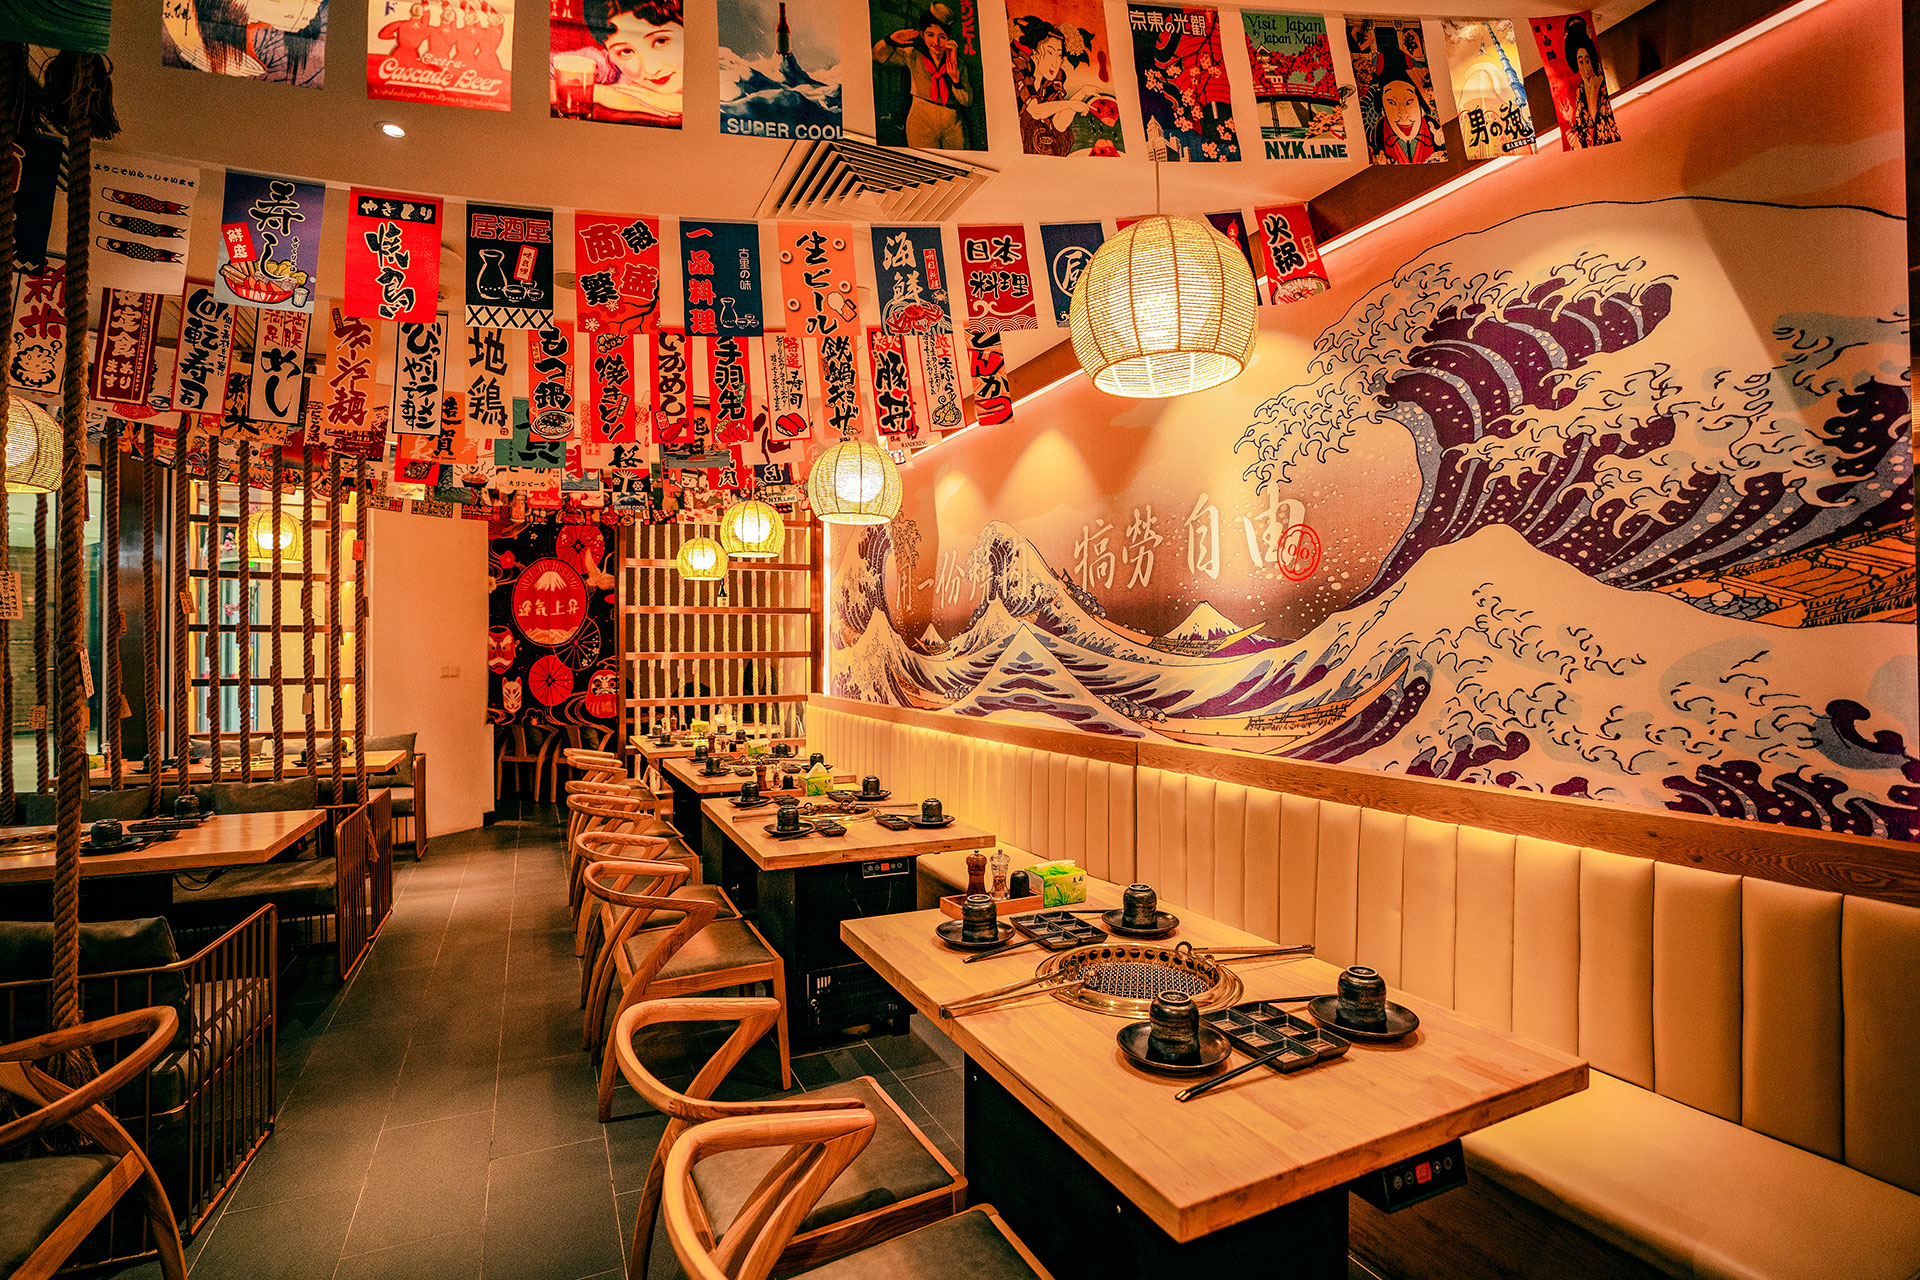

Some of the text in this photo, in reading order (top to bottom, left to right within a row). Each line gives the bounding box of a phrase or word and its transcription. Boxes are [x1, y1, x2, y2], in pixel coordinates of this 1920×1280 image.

[1247, 15, 1323, 34] Visit Japan
[1263, 32, 1291, 45] Japan
[378, 58, 503, 91] Cascade Beer
[727, 117, 844, 141] SUPER COOL
[1311, 144, 1348, 159] LINE
[470, 213, 552, 243] 居酒屋
[883, 231, 922, 304] 海鮮
[964, 235, 1024, 265] 日本
[685, 228, 719, 335] 一品料理
[738, 248, 752, 291] 古里の味
[795, 230, 837, 334] 生ビール
[968, 270, 1031, 300] 料理
[261, 348, 302, 417] めし
[533, 326, 573, 410] もつ鍋
[658, 331, 686, 416] いかめし
[714, 336, 746, 421] 手羽先
